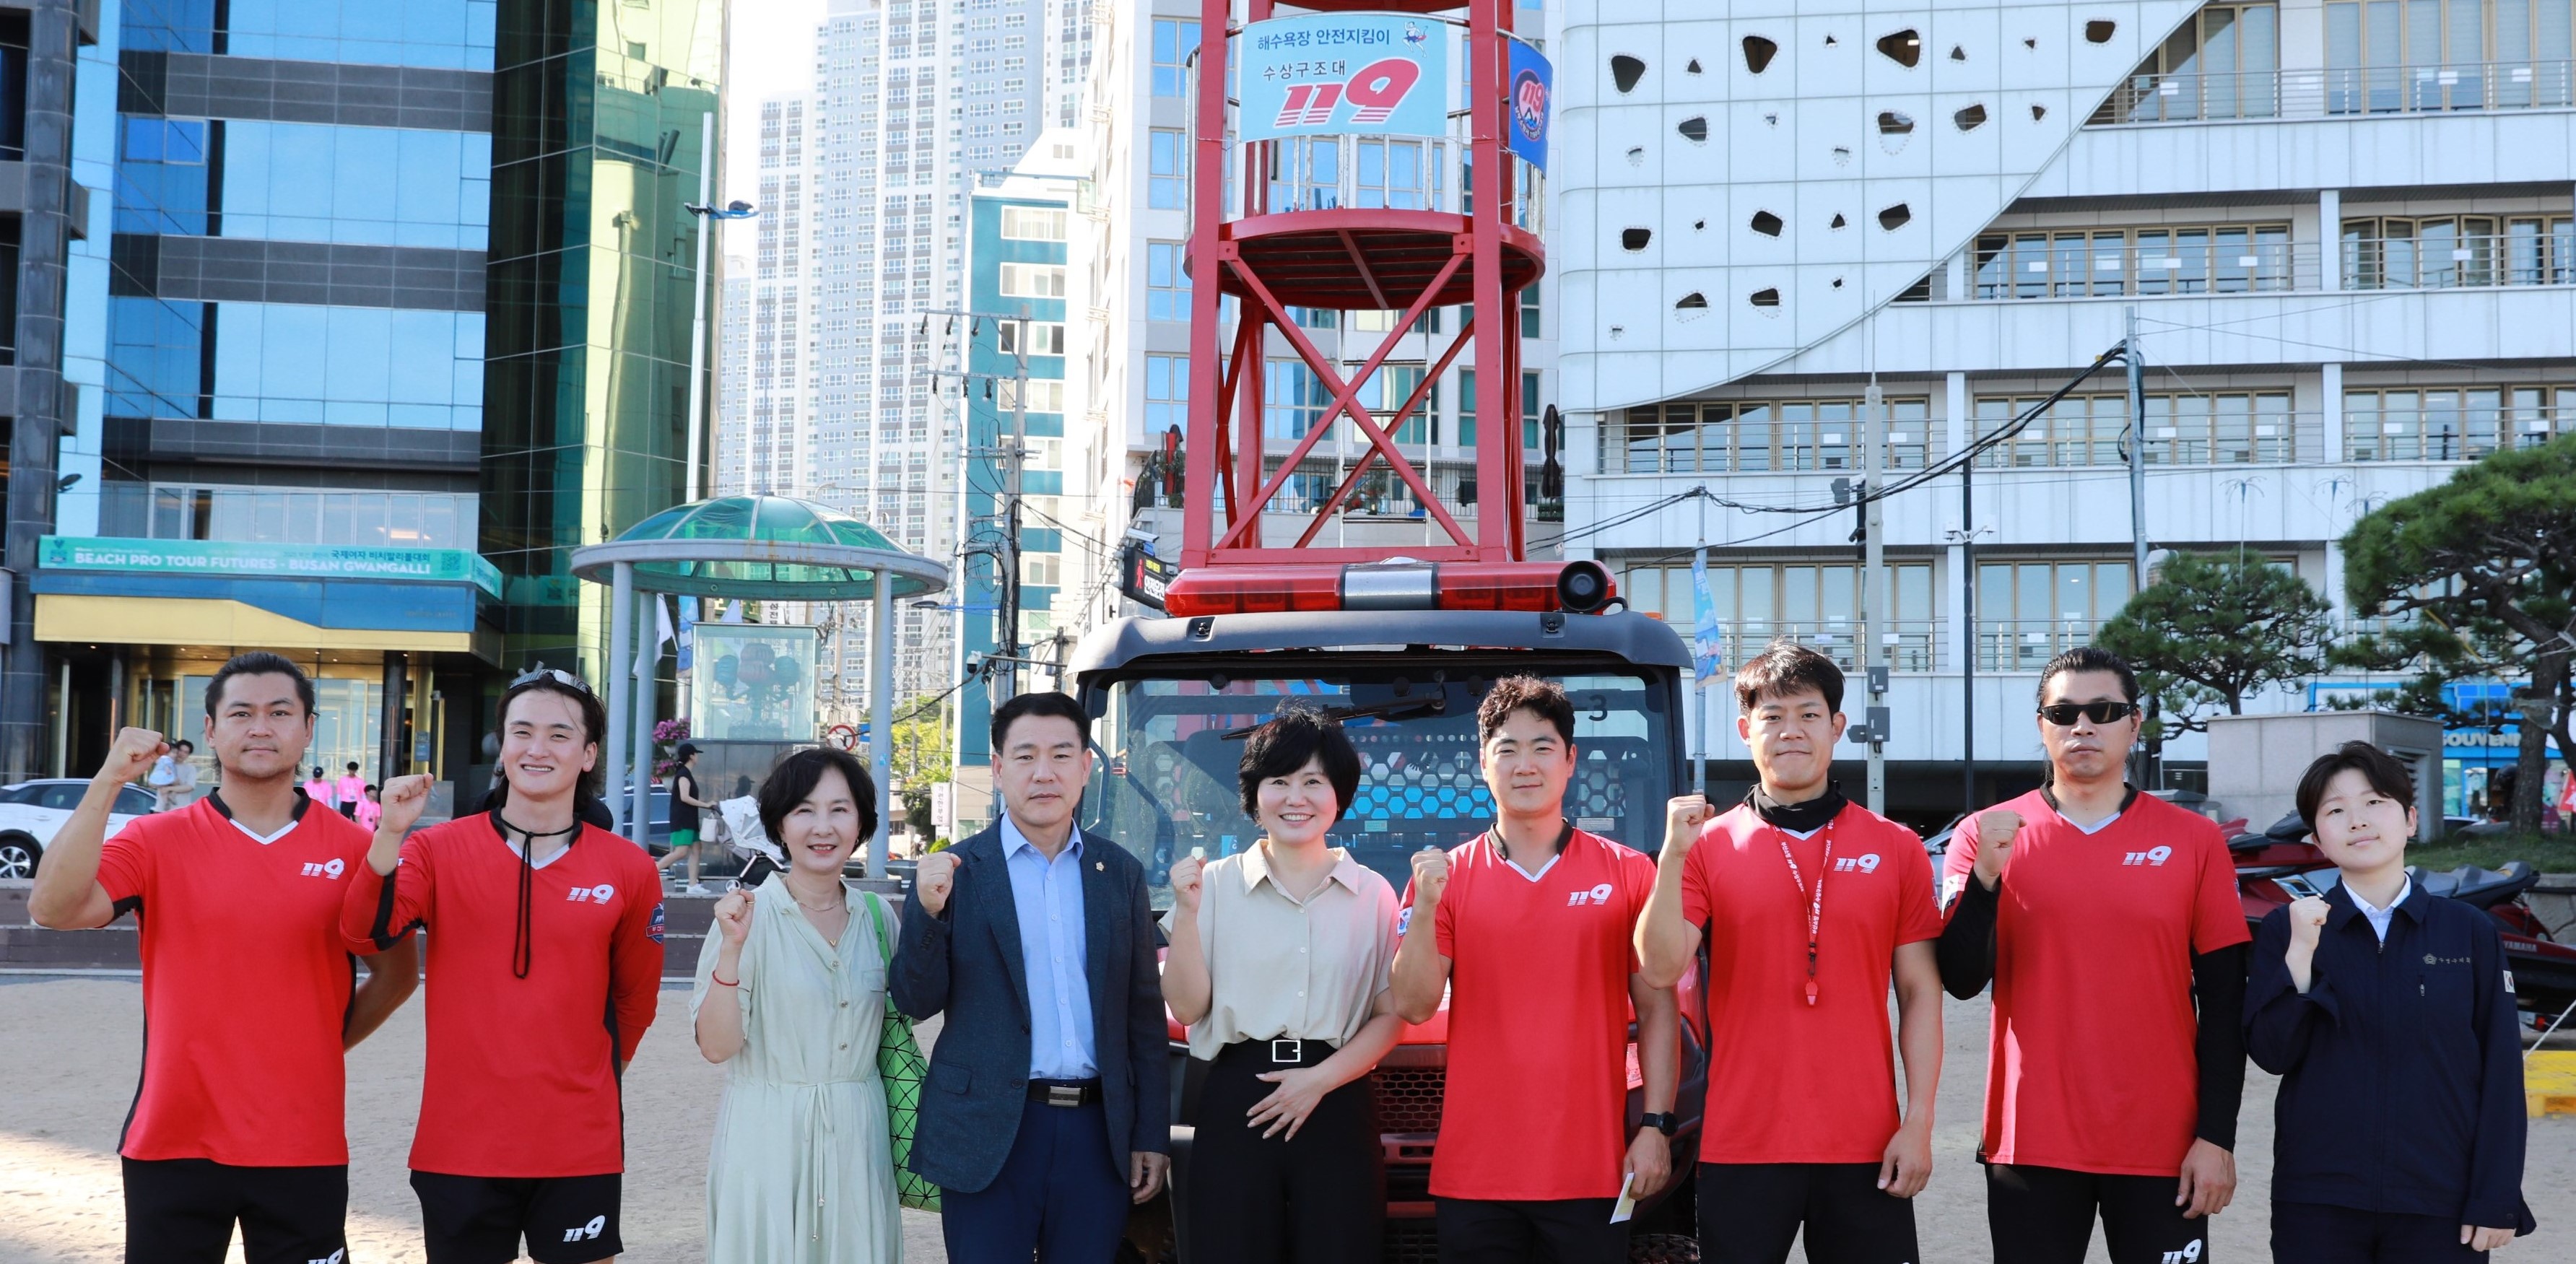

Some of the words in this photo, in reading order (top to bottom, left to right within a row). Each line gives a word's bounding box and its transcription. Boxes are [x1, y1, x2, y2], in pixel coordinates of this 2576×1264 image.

[1258, 32, 1310, 51] 해수욕장
[1316, 28, 1390, 45] 안전지킴이
[1263, 60, 1346, 81] 수상구조대
[1274, 58, 1419, 126] 119
[1523, 82, 1544, 113] 119
[75, 553, 126, 565] BEACH
[130, 554, 162, 566] PRO
[165, 555, 207, 567] TOUR
[210, 557, 277, 570] FUTURES
[290, 559, 340, 572] BUSAN
[344, 561, 430, 574] GWANGALLI
[1588, 694, 1608, 721] 3
[1833, 853, 1881, 874] 119
[2122, 845, 2172, 866] 119
[300, 858, 344, 880] 119
[566, 884, 614, 905] 119
[1567, 883, 1613, 907] 119
[2504, 941, 2537, 952] YAMAHA
[562, 1215, 606, 1242] 119
[2161, 1238, 2202, 1264] 119
